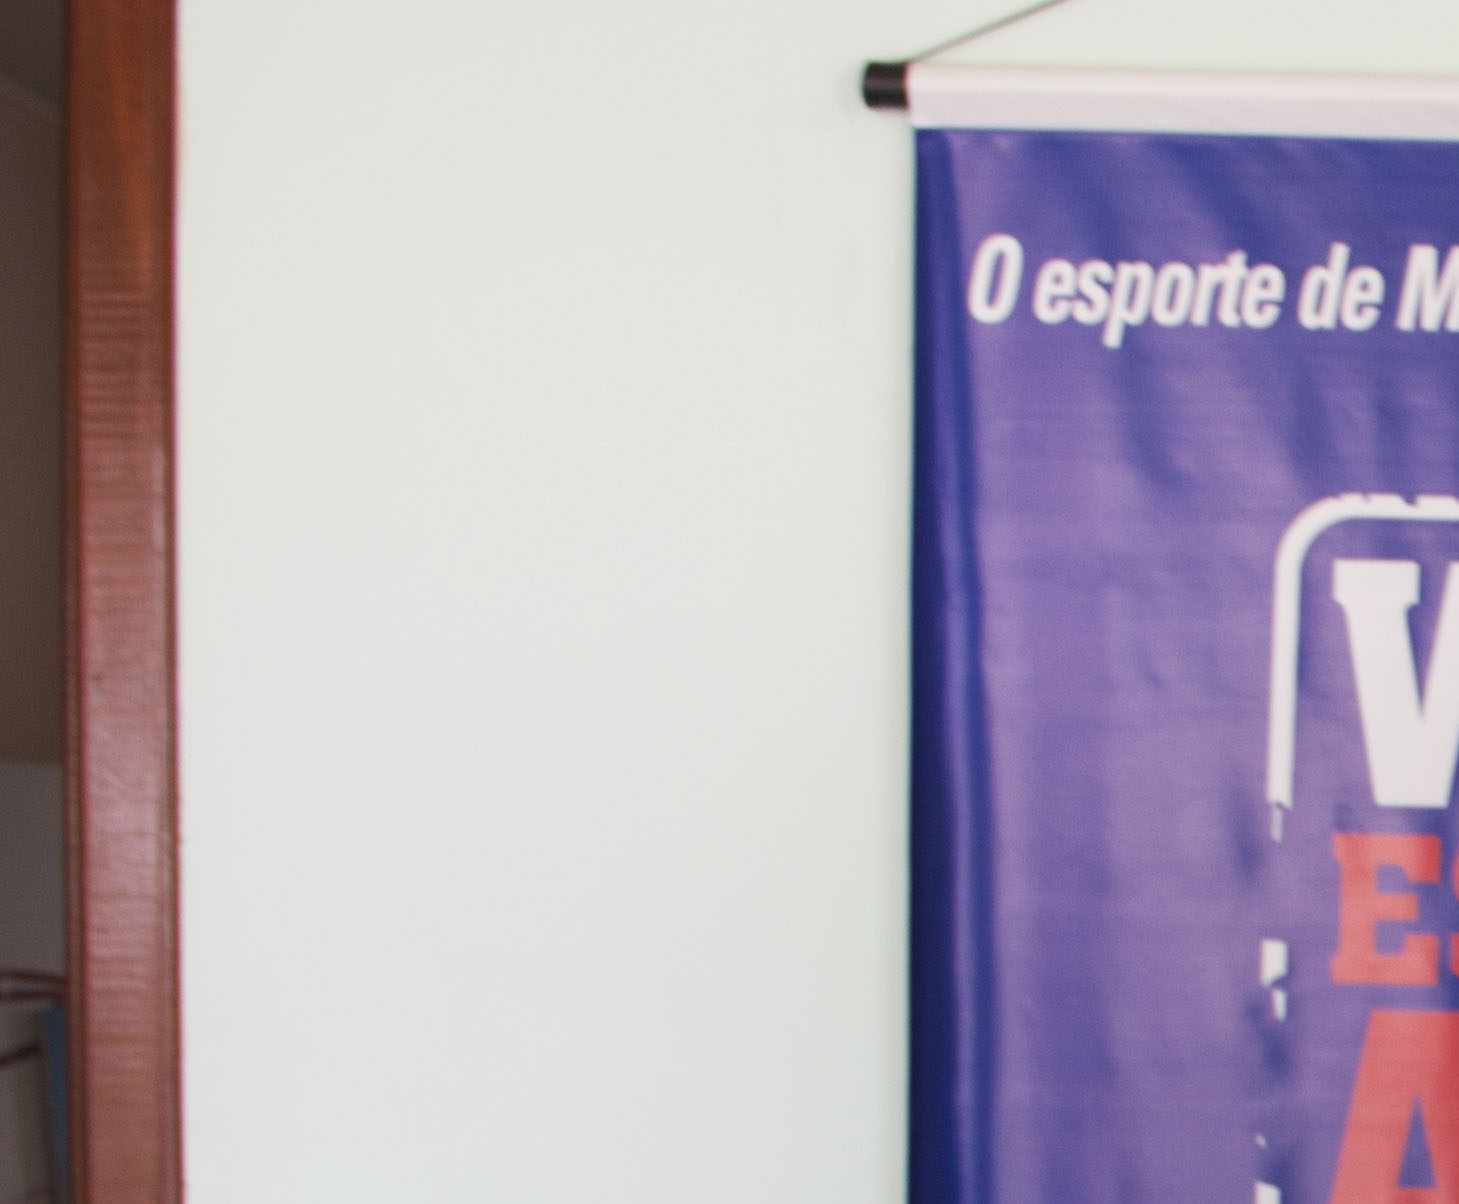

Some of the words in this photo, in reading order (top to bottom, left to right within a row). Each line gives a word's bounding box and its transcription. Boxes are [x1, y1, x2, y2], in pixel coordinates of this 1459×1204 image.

[967, 233, 1025, 326] O
[1032, 250, 1286, 350] esporte
[1297, 242, 1386, 332] de
